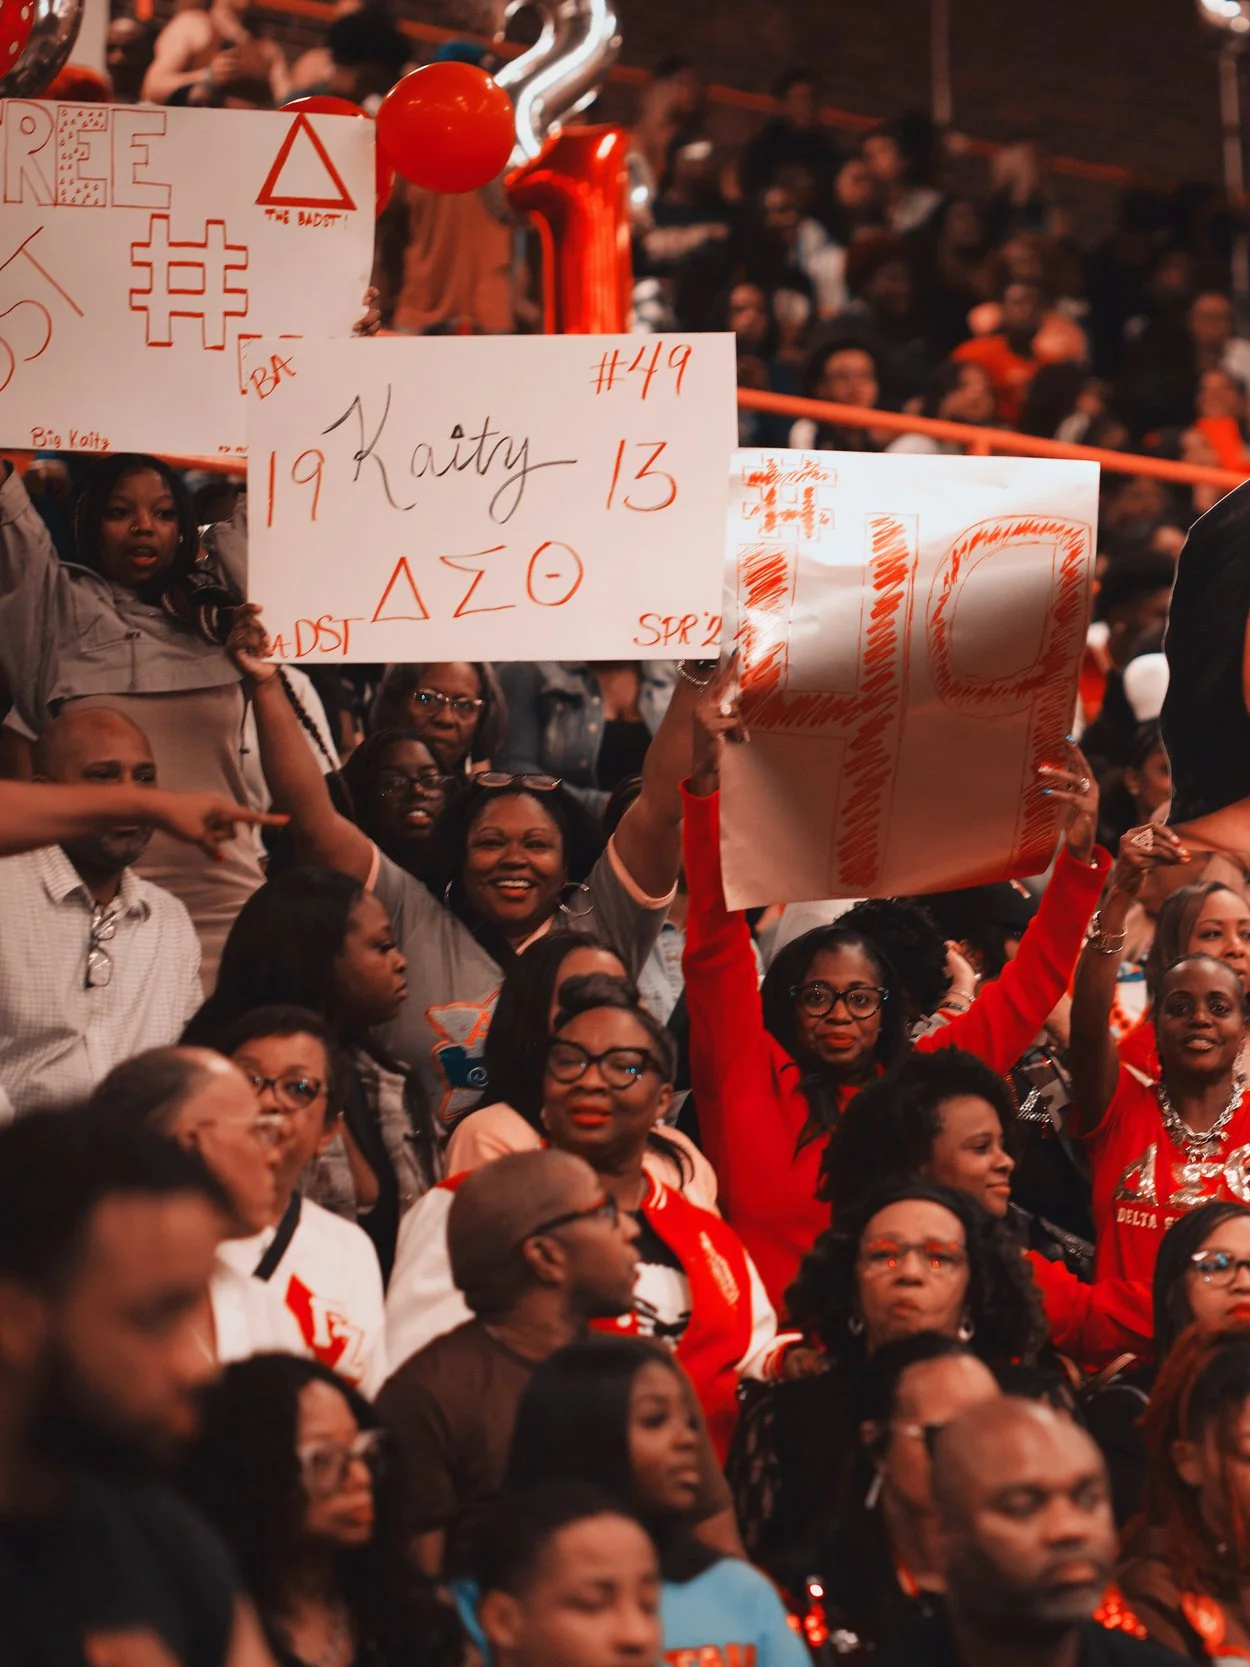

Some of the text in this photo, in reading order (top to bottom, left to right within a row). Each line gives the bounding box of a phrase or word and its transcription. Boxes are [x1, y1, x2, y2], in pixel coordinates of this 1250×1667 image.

[250, 352, 297, 400] BA
[590, 340, 693, 400] #49
[30, 426, 62, 448] Big
[266, 383, 678, 528] 19 Kaity 13
[633, 612, 698, 647] SPR
[1116, 1207, 1158, 1229] DELTA
